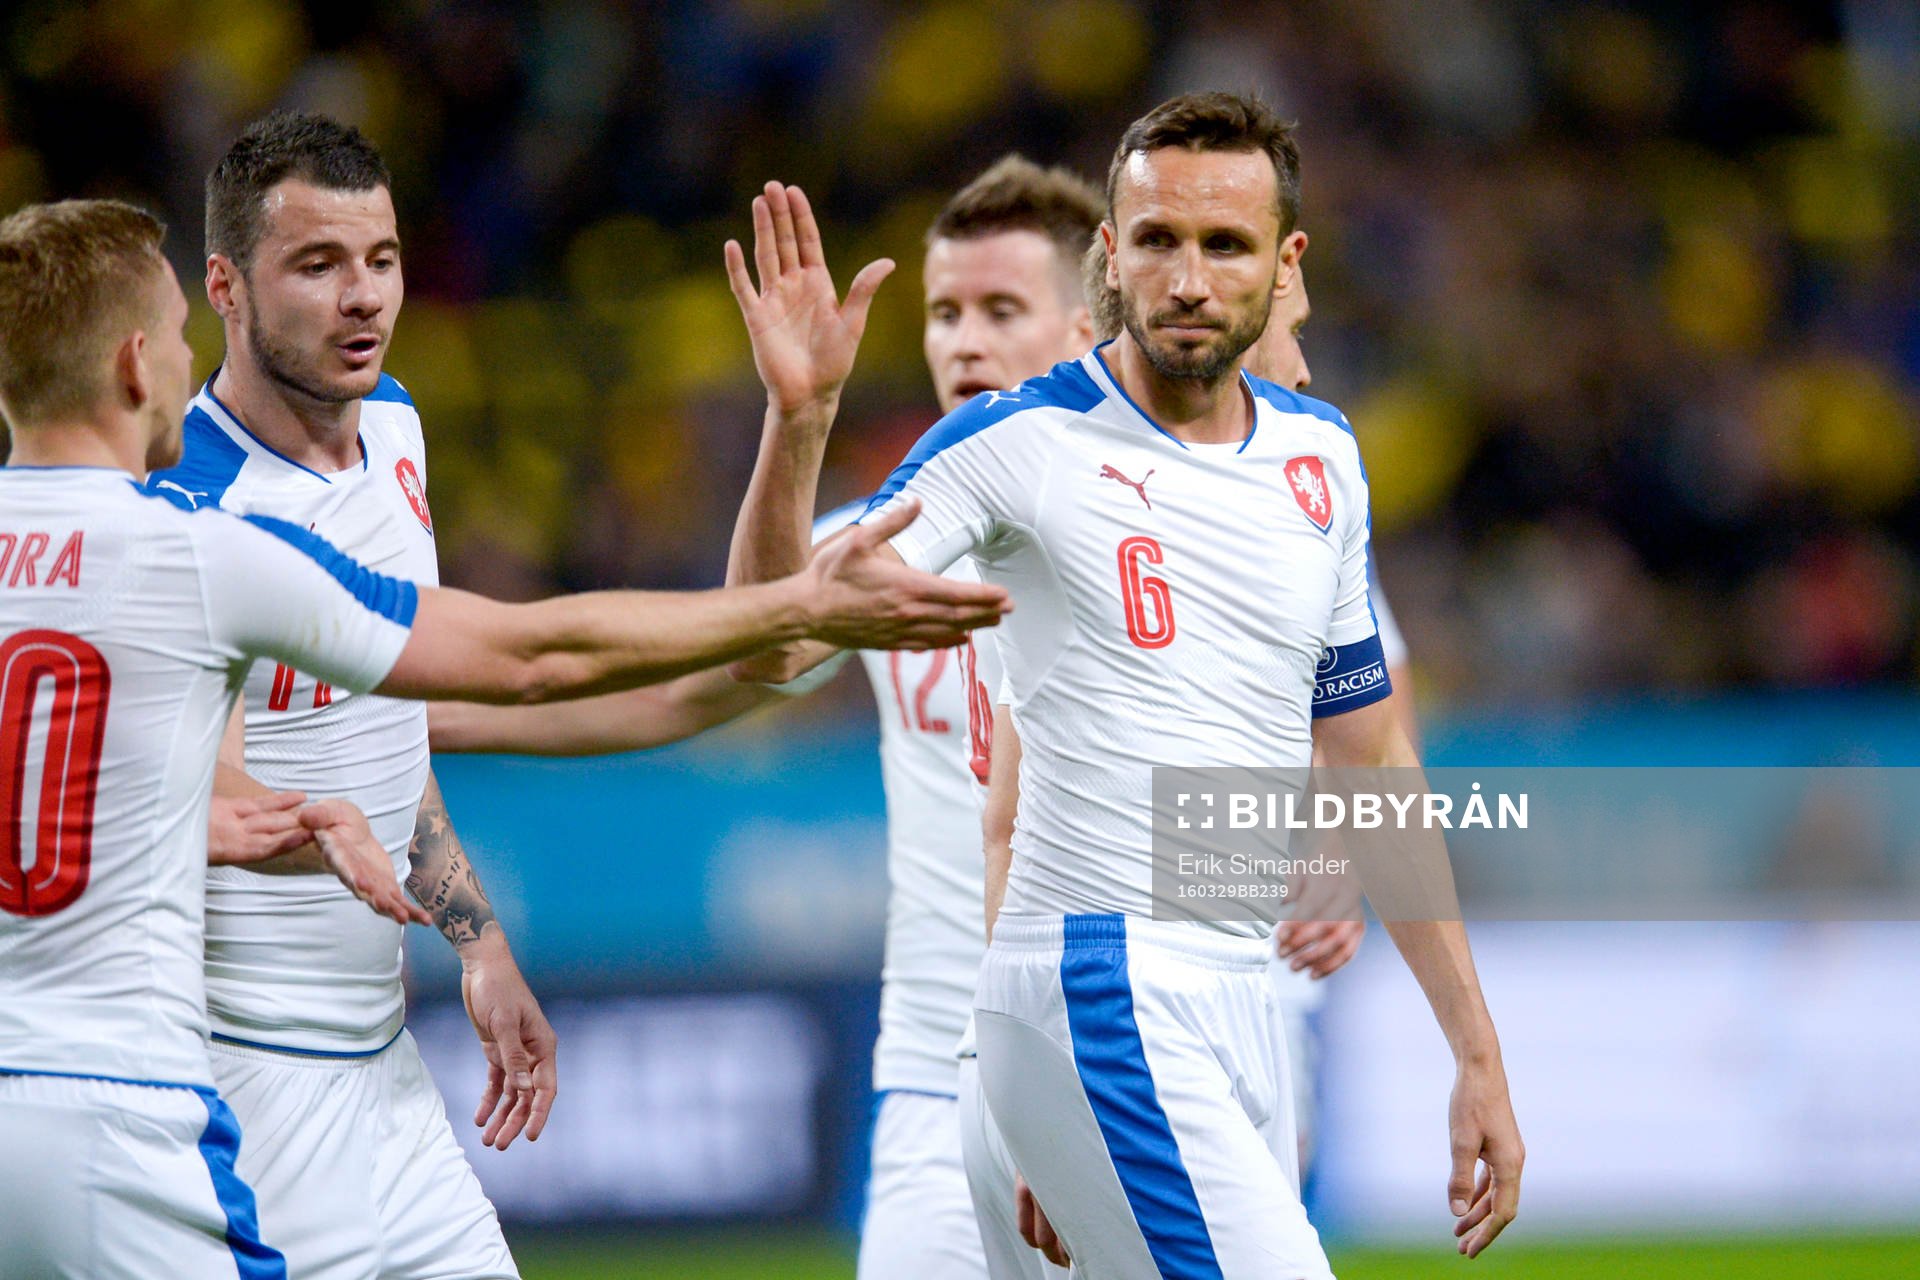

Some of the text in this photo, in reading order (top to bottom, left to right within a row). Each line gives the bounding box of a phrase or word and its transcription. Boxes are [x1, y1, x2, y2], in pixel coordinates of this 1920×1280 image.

[1117, 536, 1176, 649] 6
[1326, 665, 1385, 697] RACISM
[0, 628, 111, 917] 0
